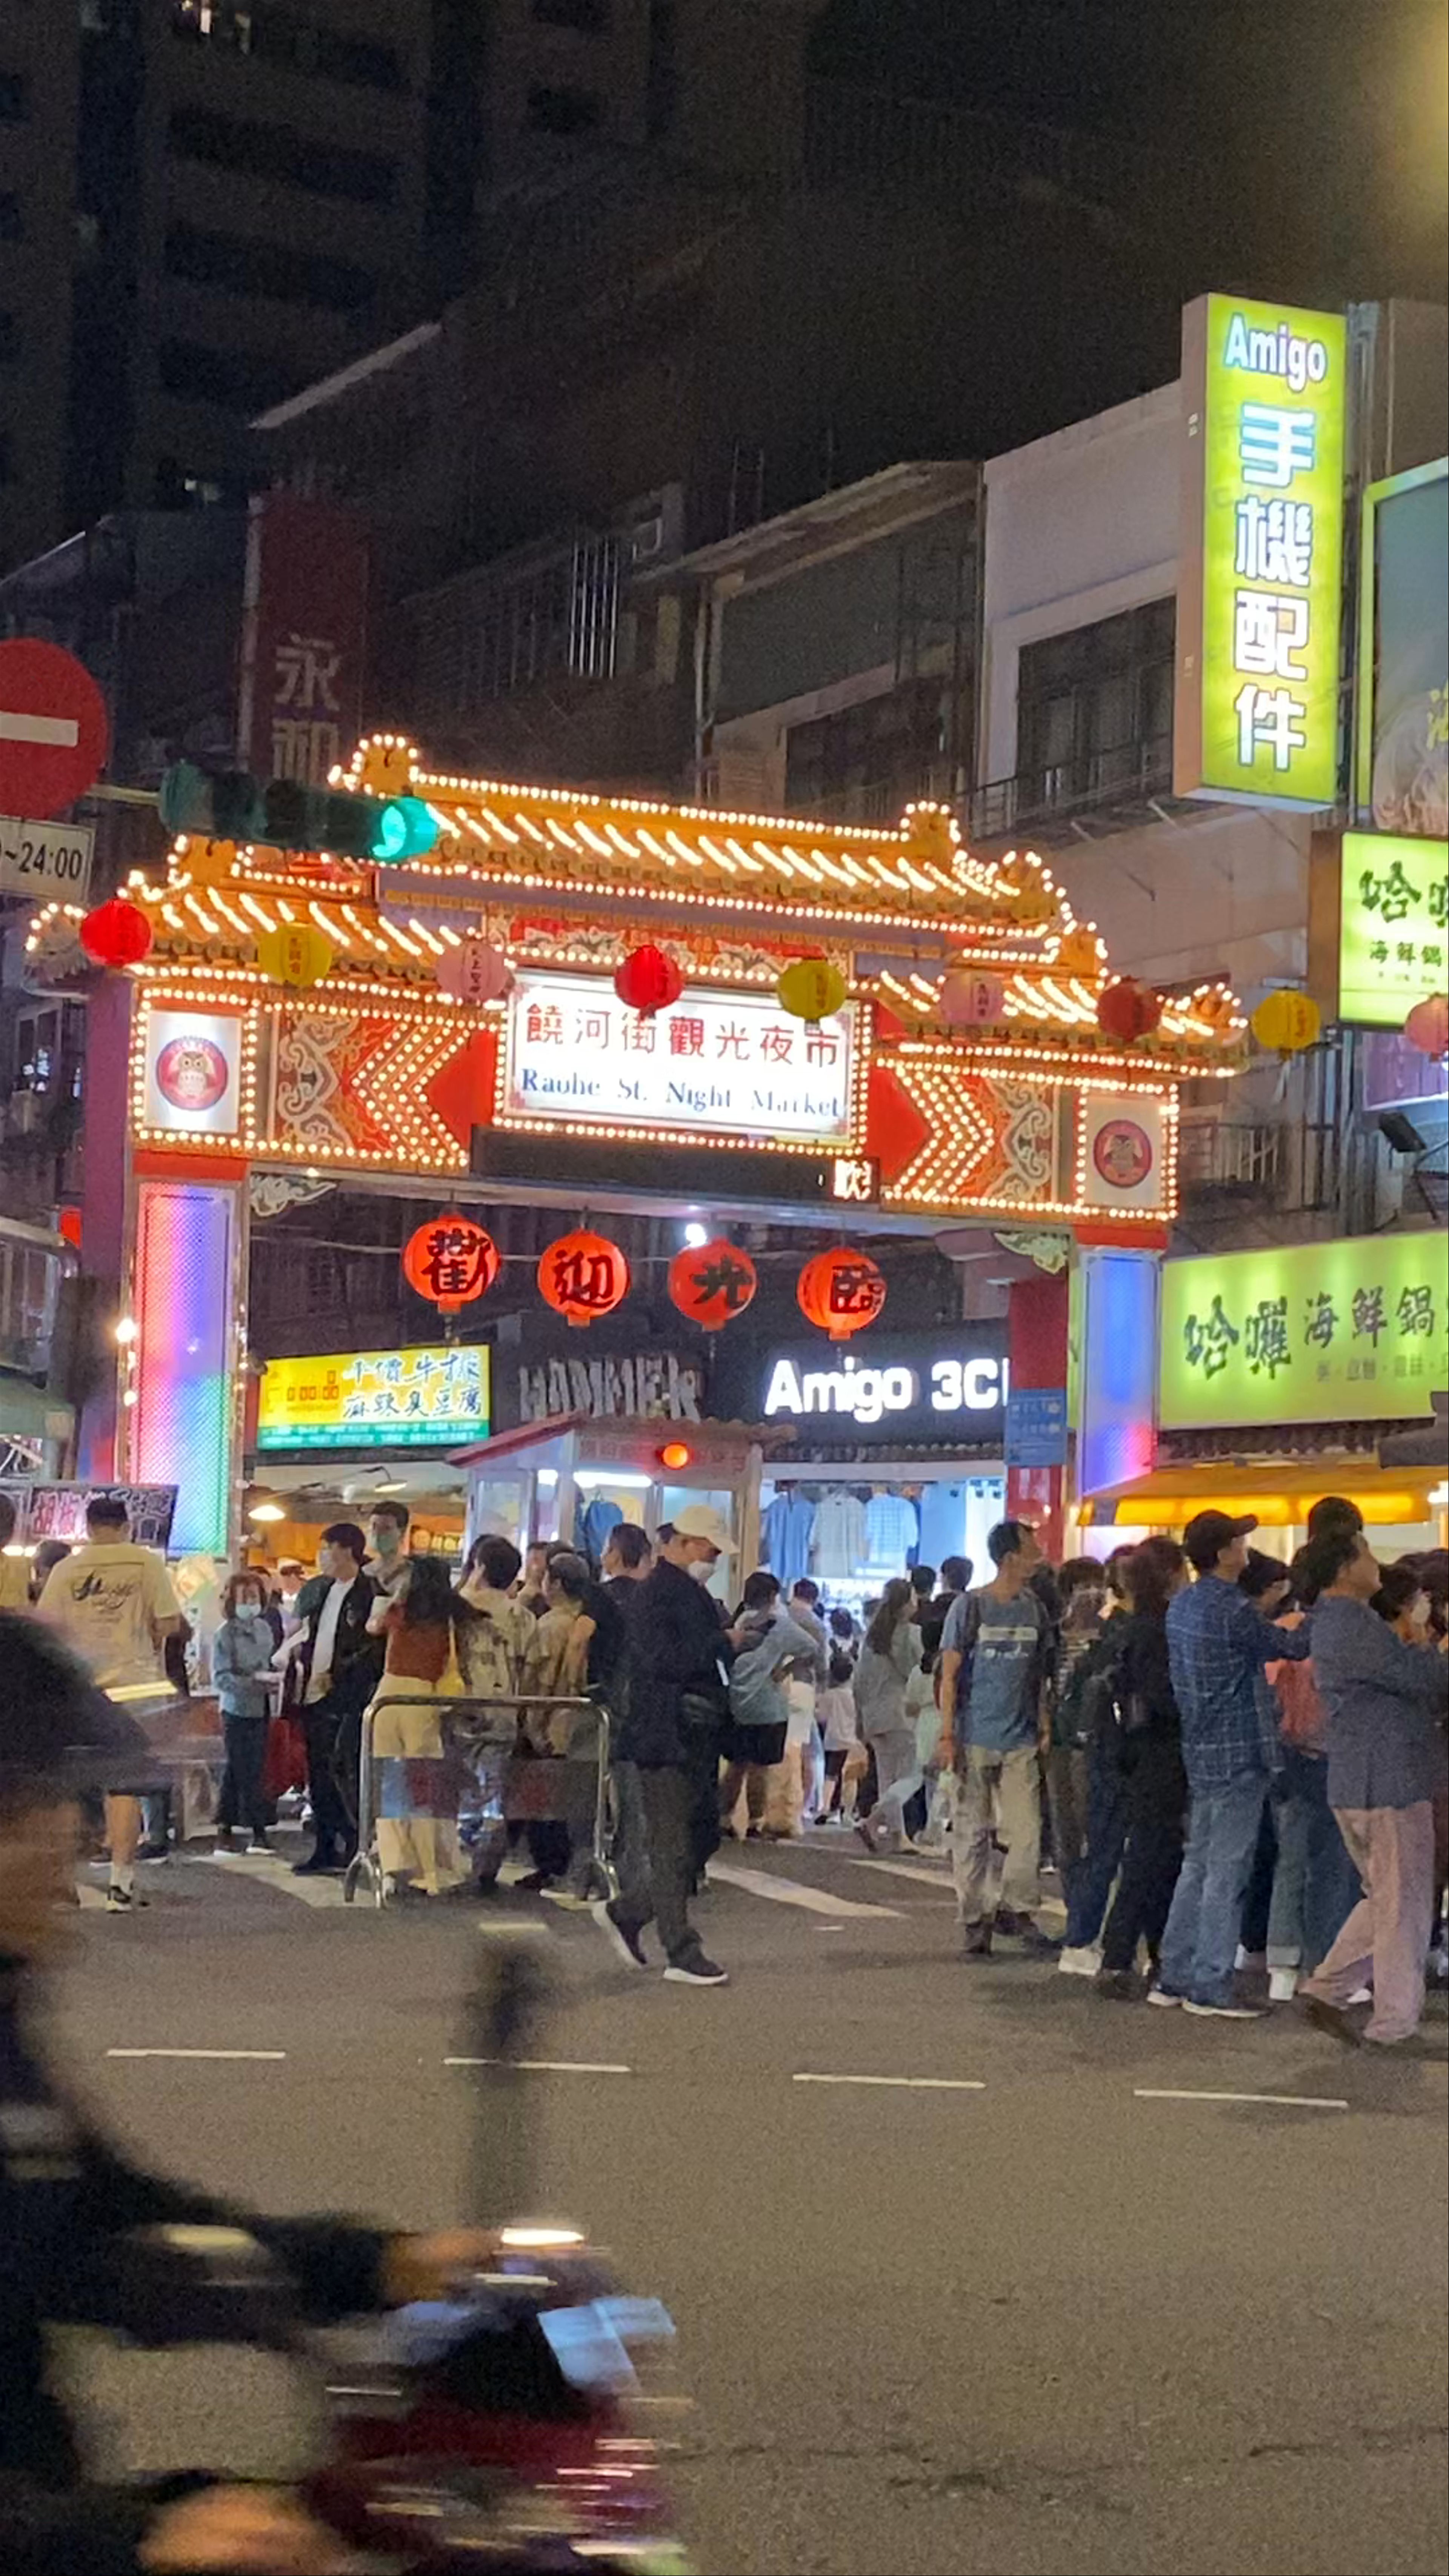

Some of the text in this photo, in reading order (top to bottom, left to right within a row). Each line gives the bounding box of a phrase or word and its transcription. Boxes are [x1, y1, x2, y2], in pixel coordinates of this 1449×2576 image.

[1224, 314, 1327, 393] Amigo
[1234, 403, 1315, 771] 手機配件
[0, 838, 82, 880] ~24:00
[526, 1002, 841, 1068] 饒河街觀光夜市
[521, 1067, 841, 1118] Raohe St. Night Market
[1184, 1285, 1449, 1380] 哈囉海鮮鍋
[764, 1356, 1009, 1423] Amigo 3C
